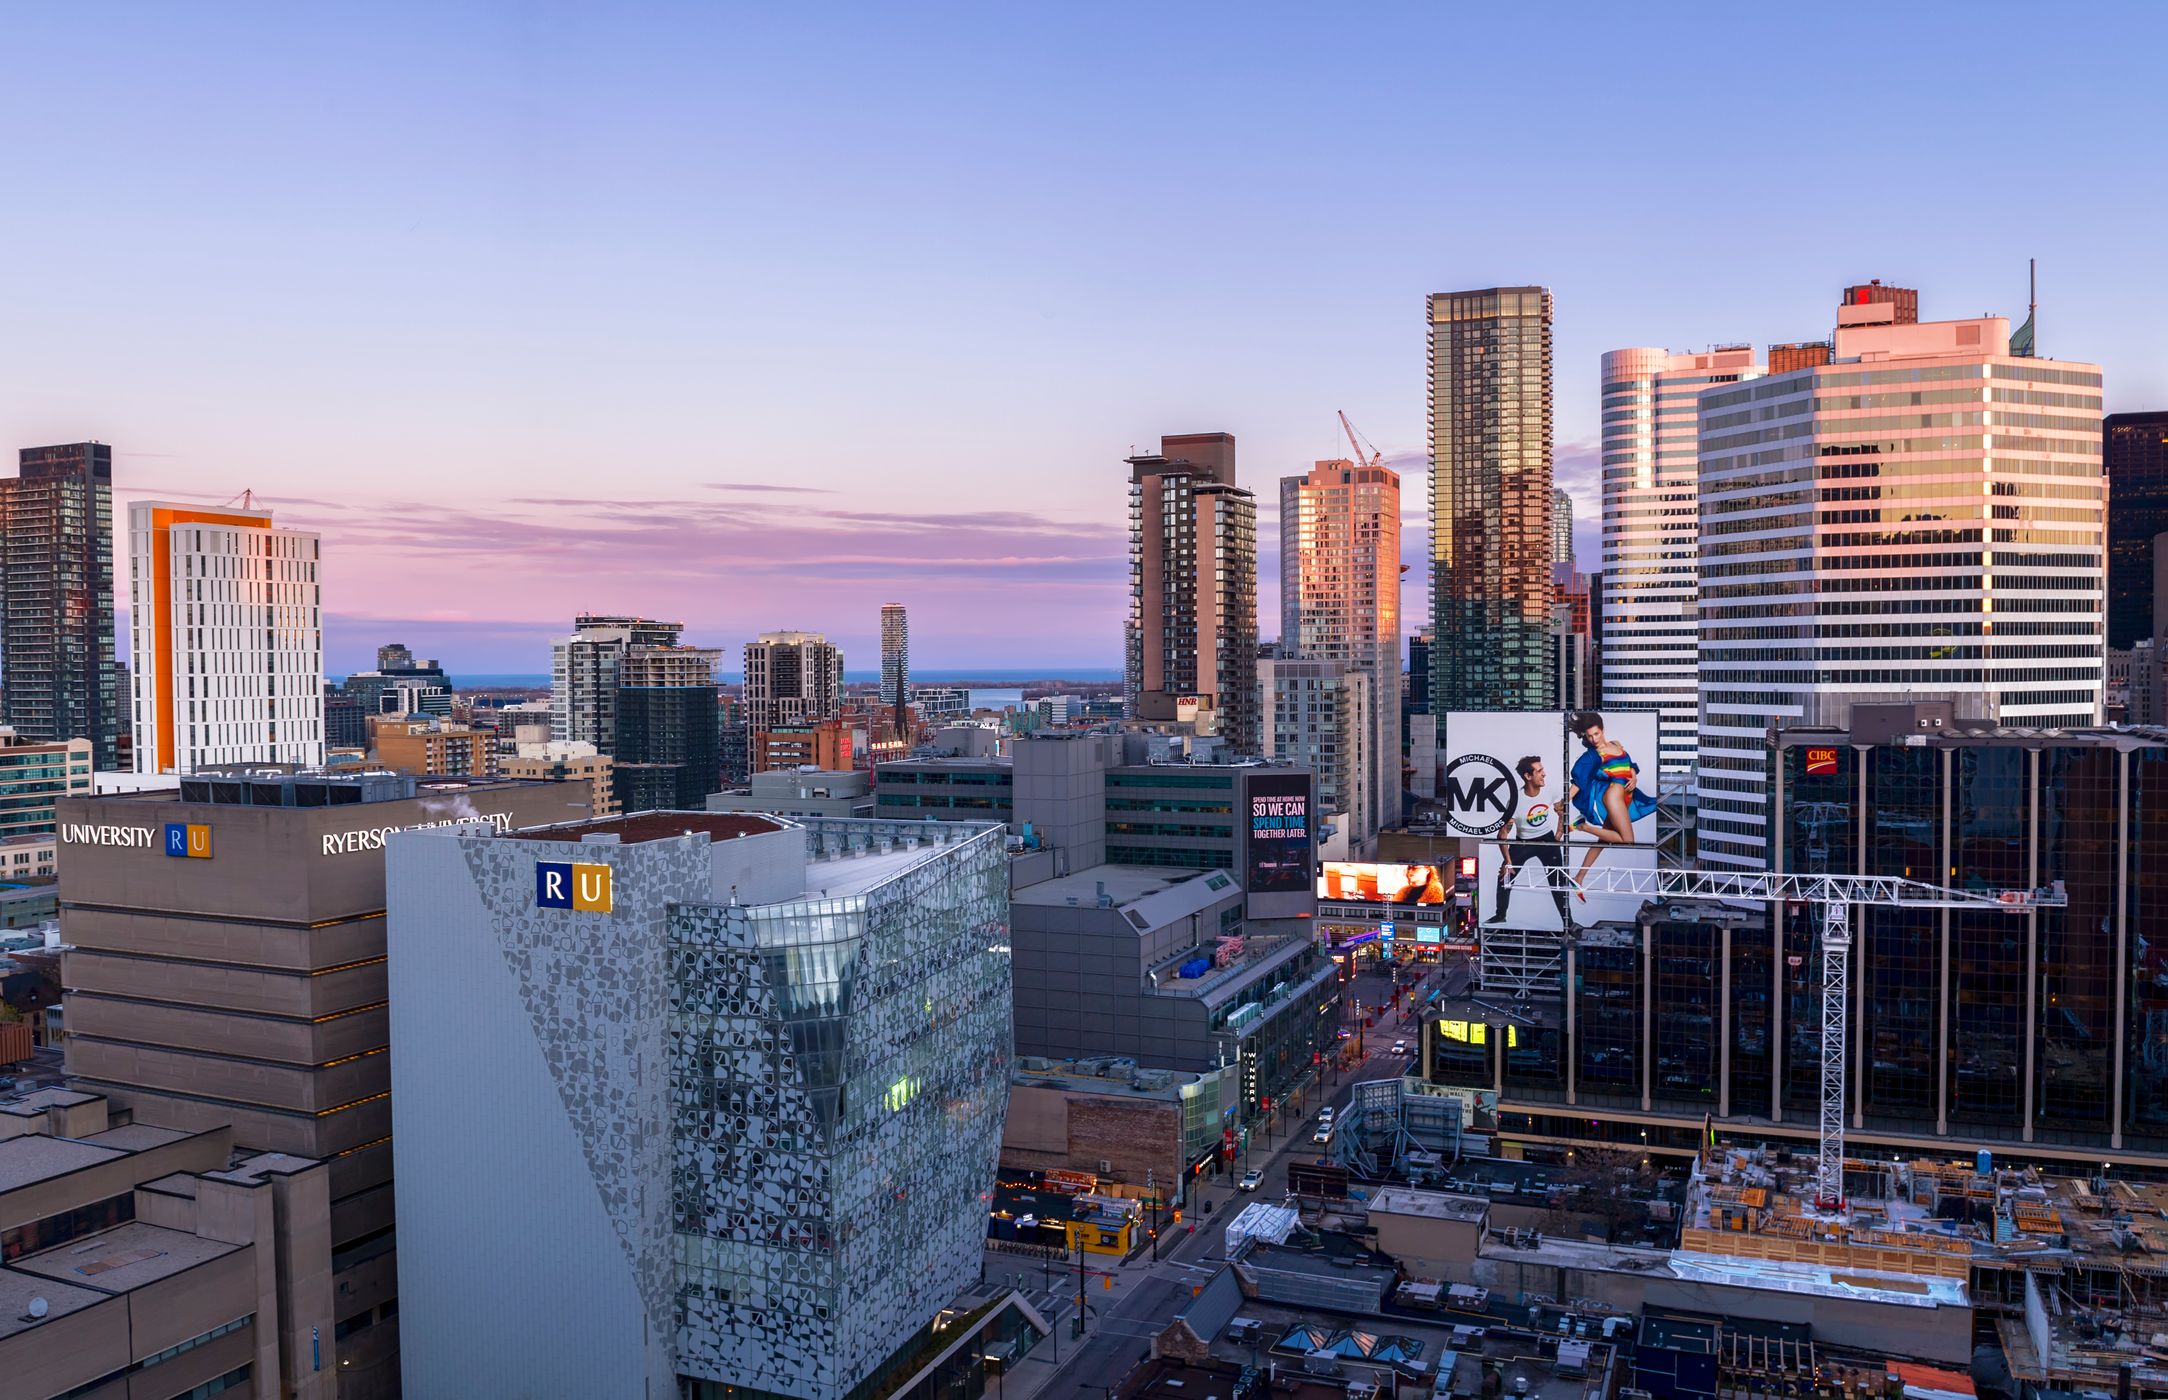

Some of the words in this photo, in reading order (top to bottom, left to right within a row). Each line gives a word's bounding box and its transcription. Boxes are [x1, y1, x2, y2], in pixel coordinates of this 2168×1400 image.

[1178, 698, 1197, 706] HNR
[1459, 754, 1494, 765] MICHAEL
[1808, 750, 1836, 761] CIBC
[1447, 777, 1508, 813] MK
[1253, 803, 1266, 817] SO
[1268, 803, 1284, 816] WE
[1285, 802, 1305, 816] CAN
[1253, 816, 1283, 830] SPEND
[1283, 815, 1306, 829] TIME
[1449, 818, 1483, 835] MICHAEL
[1485, 819, 1506, 833] KORS
[62, 824, 156, 848] UNIVERSITY
[322, 826, 406, 856] RYERSO
[1254, 829, 1286, 839] TOGETHER
[1286, 828, 1307, 838] LATER.
[1248, 1052, 1257, 1103] WINNERS
